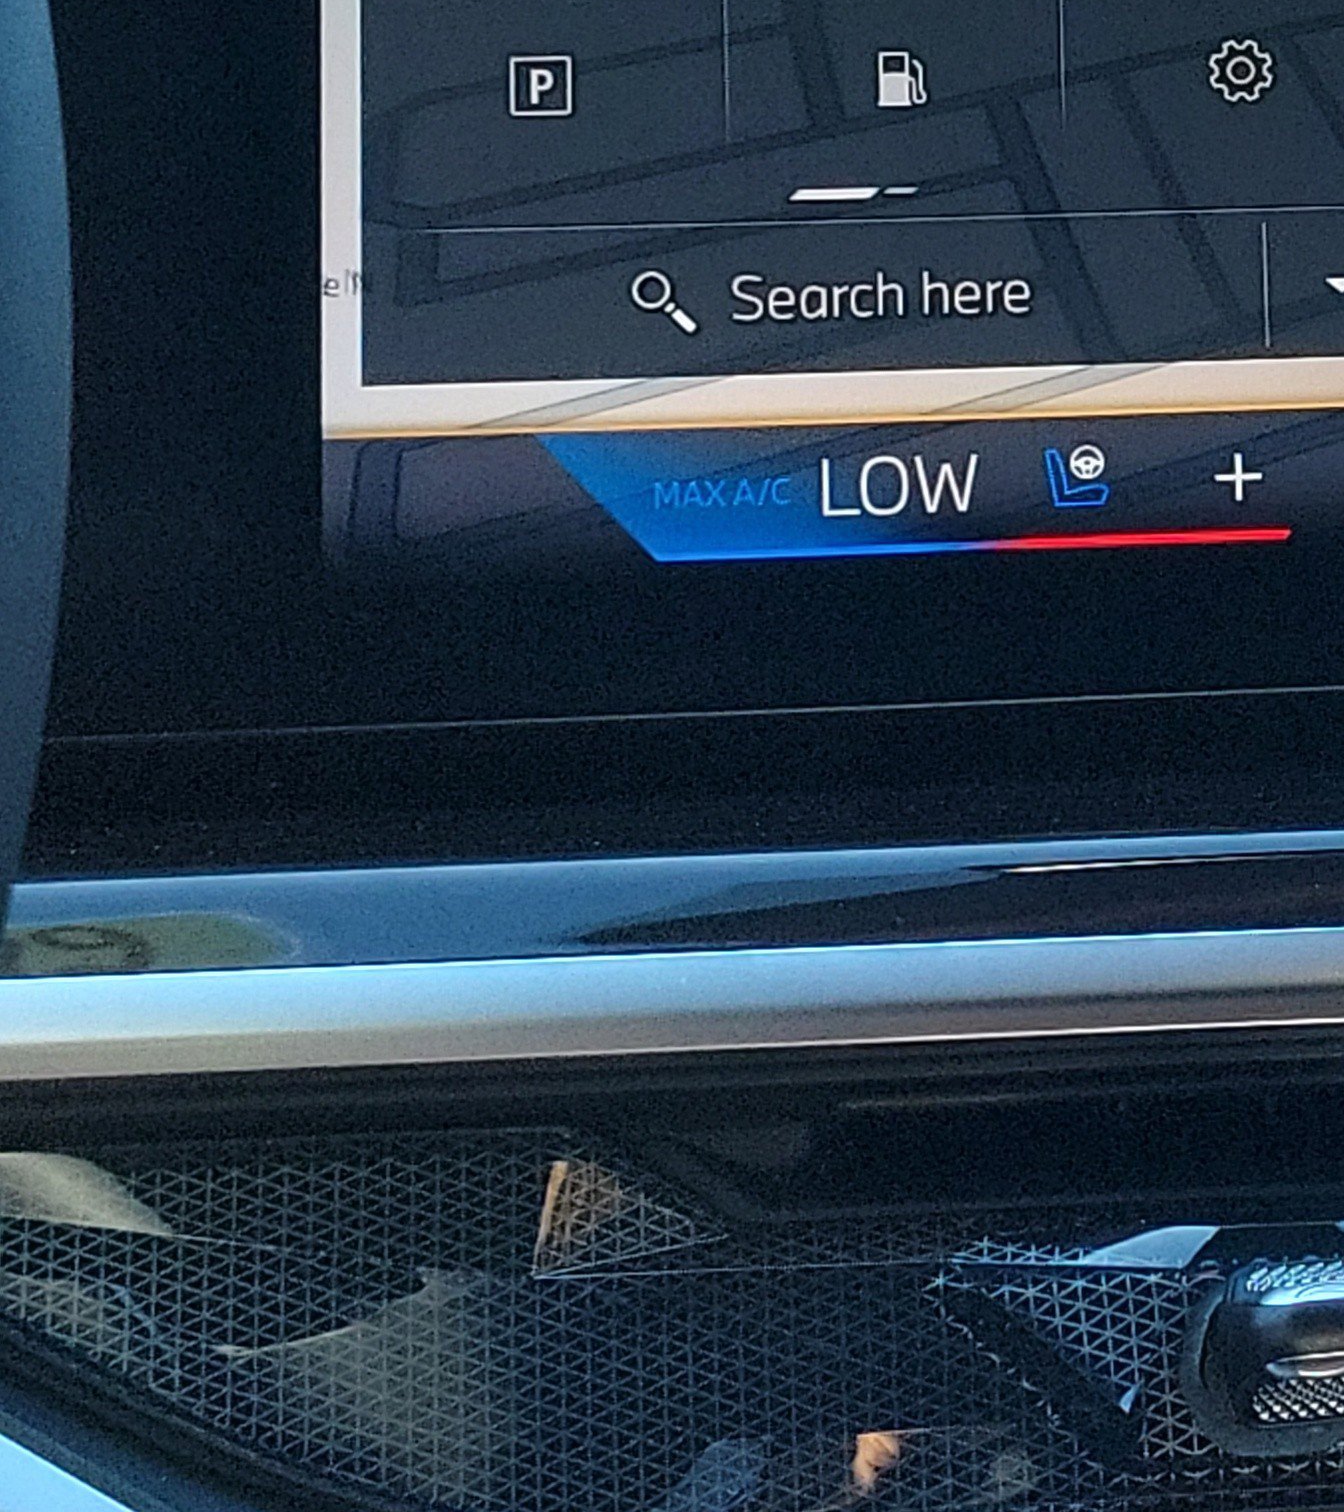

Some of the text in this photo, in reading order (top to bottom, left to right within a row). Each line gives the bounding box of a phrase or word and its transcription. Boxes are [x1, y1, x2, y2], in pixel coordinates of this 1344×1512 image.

[730, 270, 1031, 324] Search here
[653, 476, 792, 509] MAX A/C
[819, 453, 980, 517] LOW
